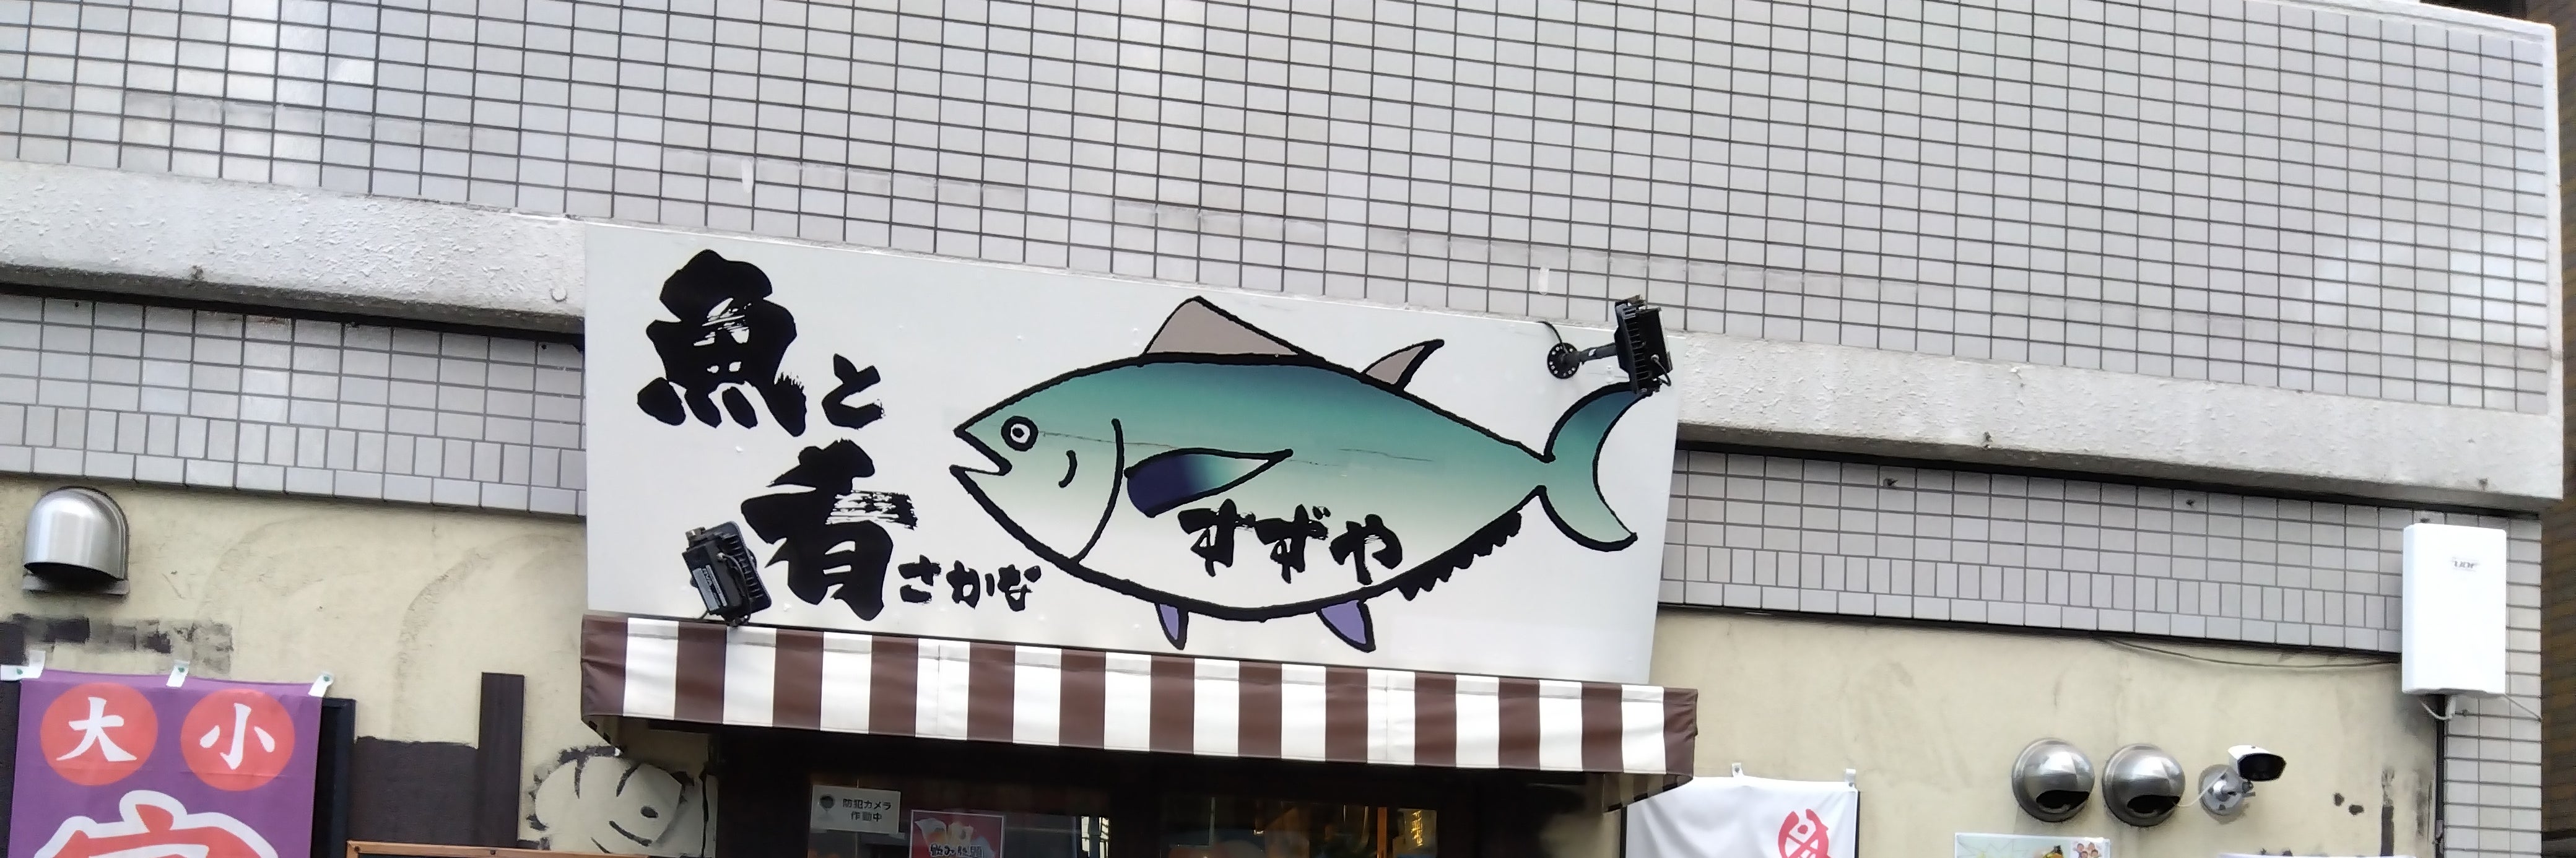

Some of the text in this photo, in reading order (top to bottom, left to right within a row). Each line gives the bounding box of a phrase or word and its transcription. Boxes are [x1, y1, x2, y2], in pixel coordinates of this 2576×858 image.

[637, 249, 886, 437] 魚と
[741, 437, 1042, 621] 肴 さかな
[1177, 498, 1403, 586] すずや
[56, 696, 276, 771] 大 小
[842, 798, 892, 810] 防犯カメラ
[851, 811, 882, 822] 作動中
